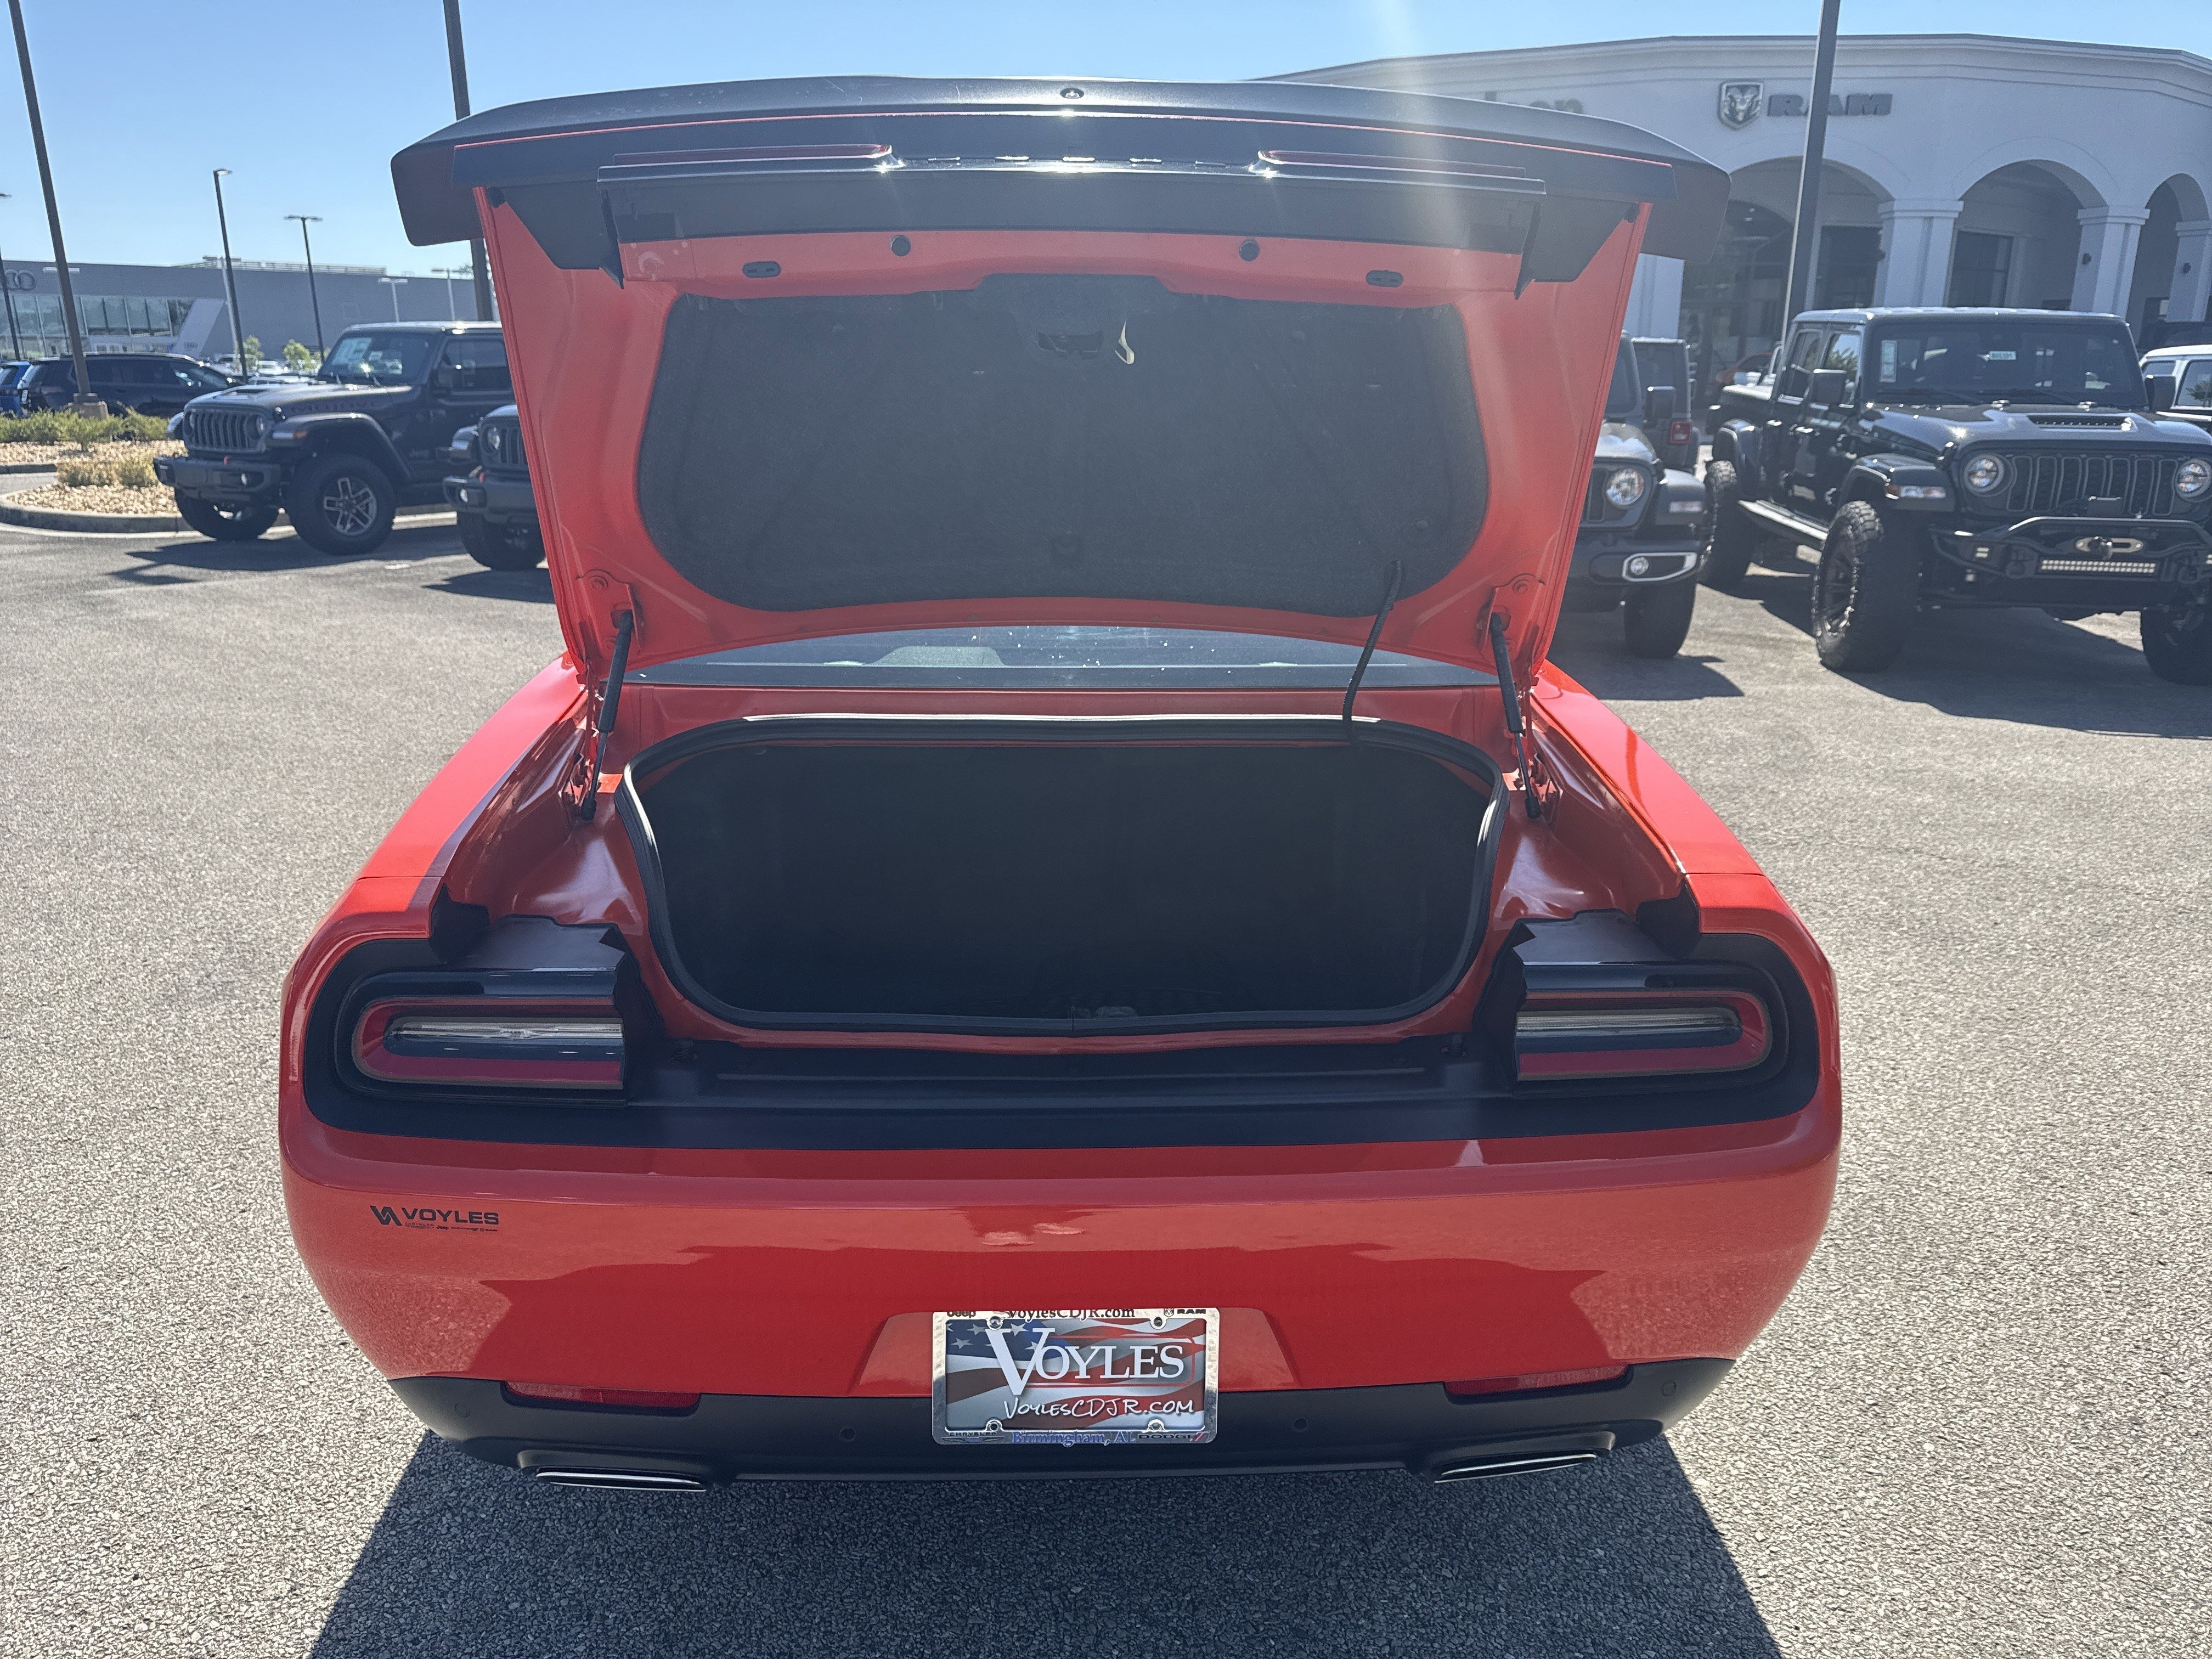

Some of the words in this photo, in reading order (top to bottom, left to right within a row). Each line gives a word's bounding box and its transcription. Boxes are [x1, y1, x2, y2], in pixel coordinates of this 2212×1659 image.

[401, 1207, 499, 1225] VOYLES
[985, 1328, 1184, 1396] VOYLES
[1011, 1431, 1110, 1446] Birmingham,
[1114, 1431, 1136, 1443] AL
